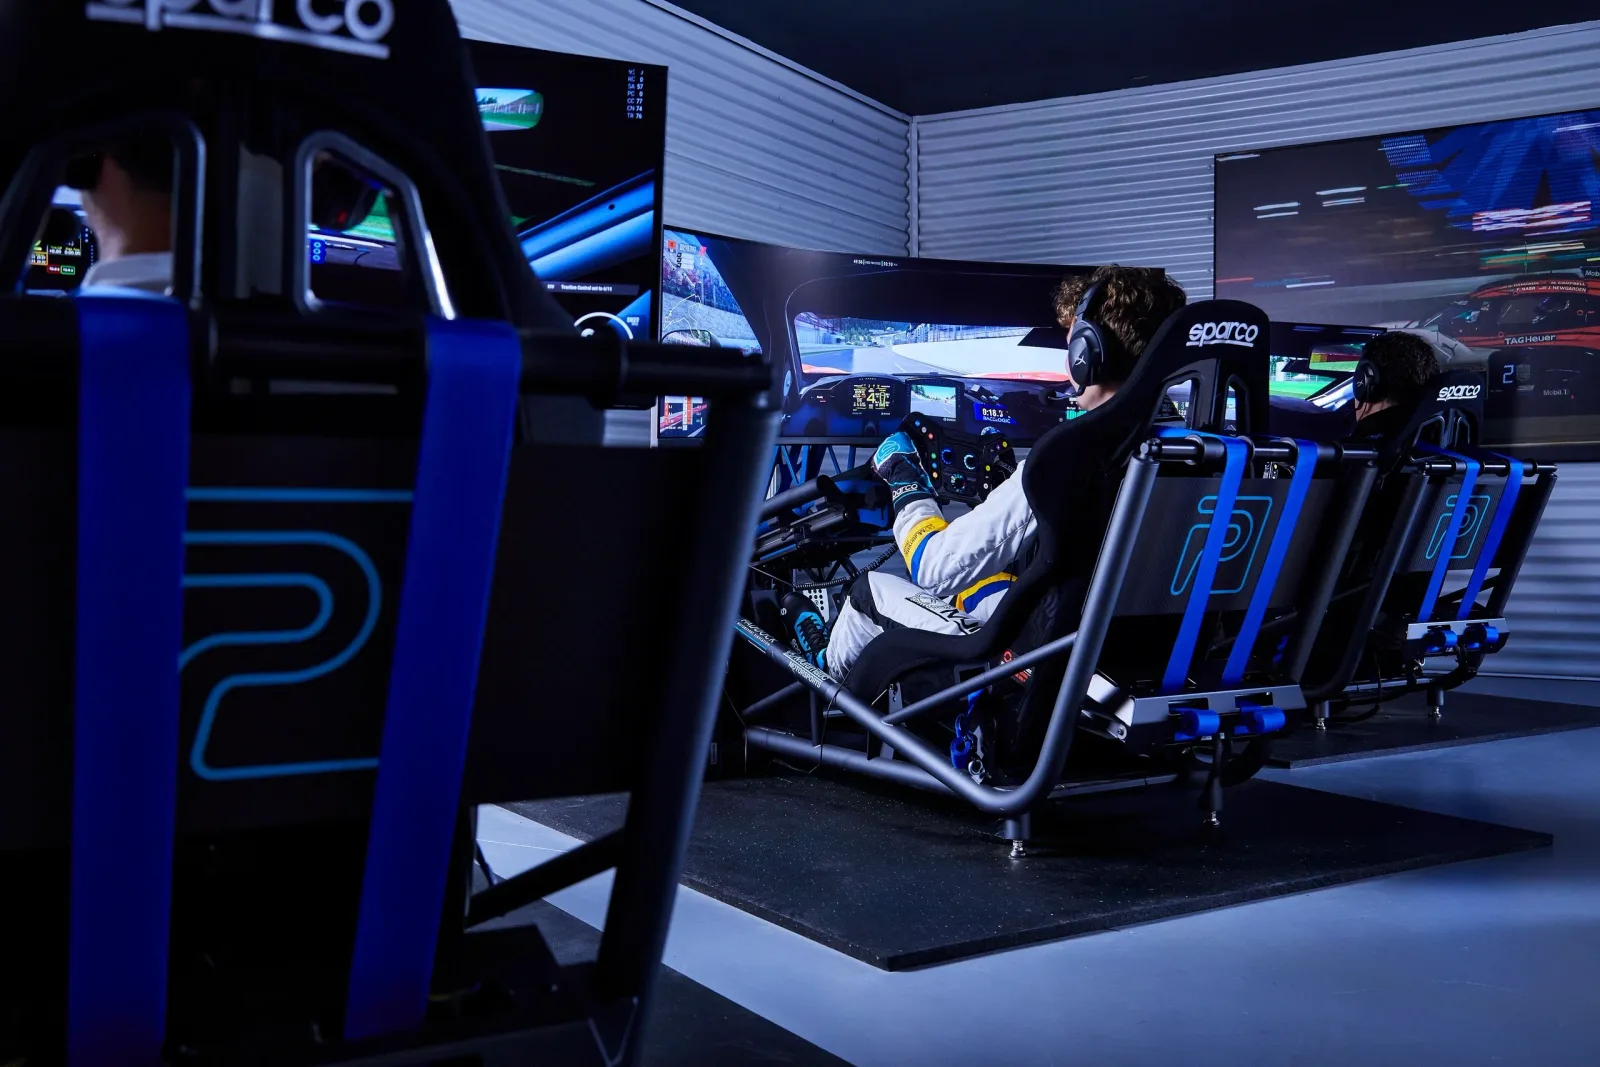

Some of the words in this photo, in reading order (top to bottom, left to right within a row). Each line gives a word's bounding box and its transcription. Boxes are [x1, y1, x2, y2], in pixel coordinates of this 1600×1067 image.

[1187, 321, 1259, 347] sparco
[1502, 364, 1514, 384] 2
[866, 392, 876, 404] 4
[1438, 385, 1481, 401] sparco
[788, 660, 822, 688] MOTORSPORTS
